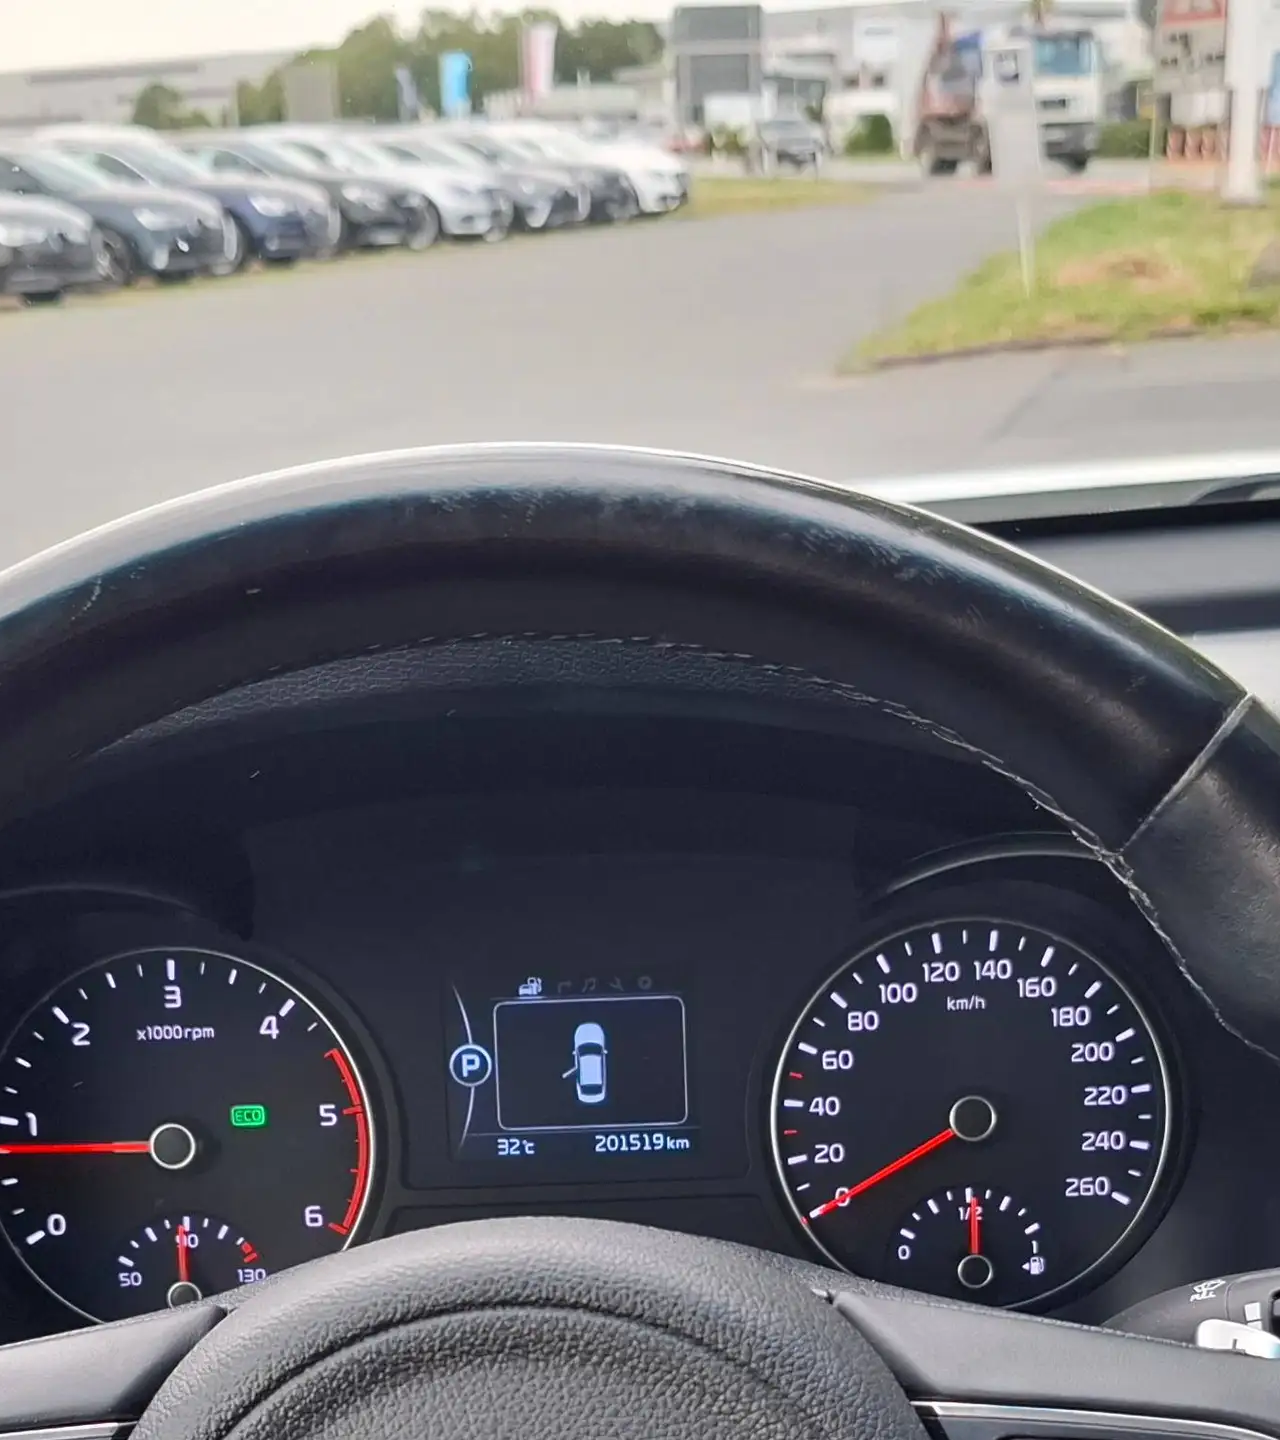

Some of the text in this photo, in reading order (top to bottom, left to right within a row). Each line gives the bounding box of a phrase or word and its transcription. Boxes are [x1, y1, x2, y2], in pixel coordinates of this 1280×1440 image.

[922, 962, 960, 982] 120
[975, 959, 1012, 980] 140
[164, 986, 181, 1008] 3
[879, 983, 917, 1003] 100
[1018, 977, 1056, 998] 160
[947, 994, 985, 1011] km/h
[848, 1011, 879, 1031] 80
[1051, 1007, 1090, 1026] 180
[72, 1023, 90, 1045] 2
[260, 1016, 279, 1039] 4
[823, 1050, 853, 1070] 60
[1071, 1042, 1115, 1062] 200
[461, 1054, 480, 1077] P
[1084, 1086, 1125, 1106] 220
[235, 1109, 261, 1122] ECO
[320, 1105, 337, 1125] 5
[809, 1097, 840, 1116] 40
[25, 1112, 37, 1136] 1
[1082, 1131, 1124, 1151] 240
[815, 1144, 844, 1163] 20
[1065, 1177, 1110, 1197] 260
[48, 1214, 66, 1236] 0
[304, 1206, 323, 1226] 6
[898, 1246, 910, 1259] 0
[119, 1272, 142, 1287] 50
[237, 1269, 266, 1282] 130
